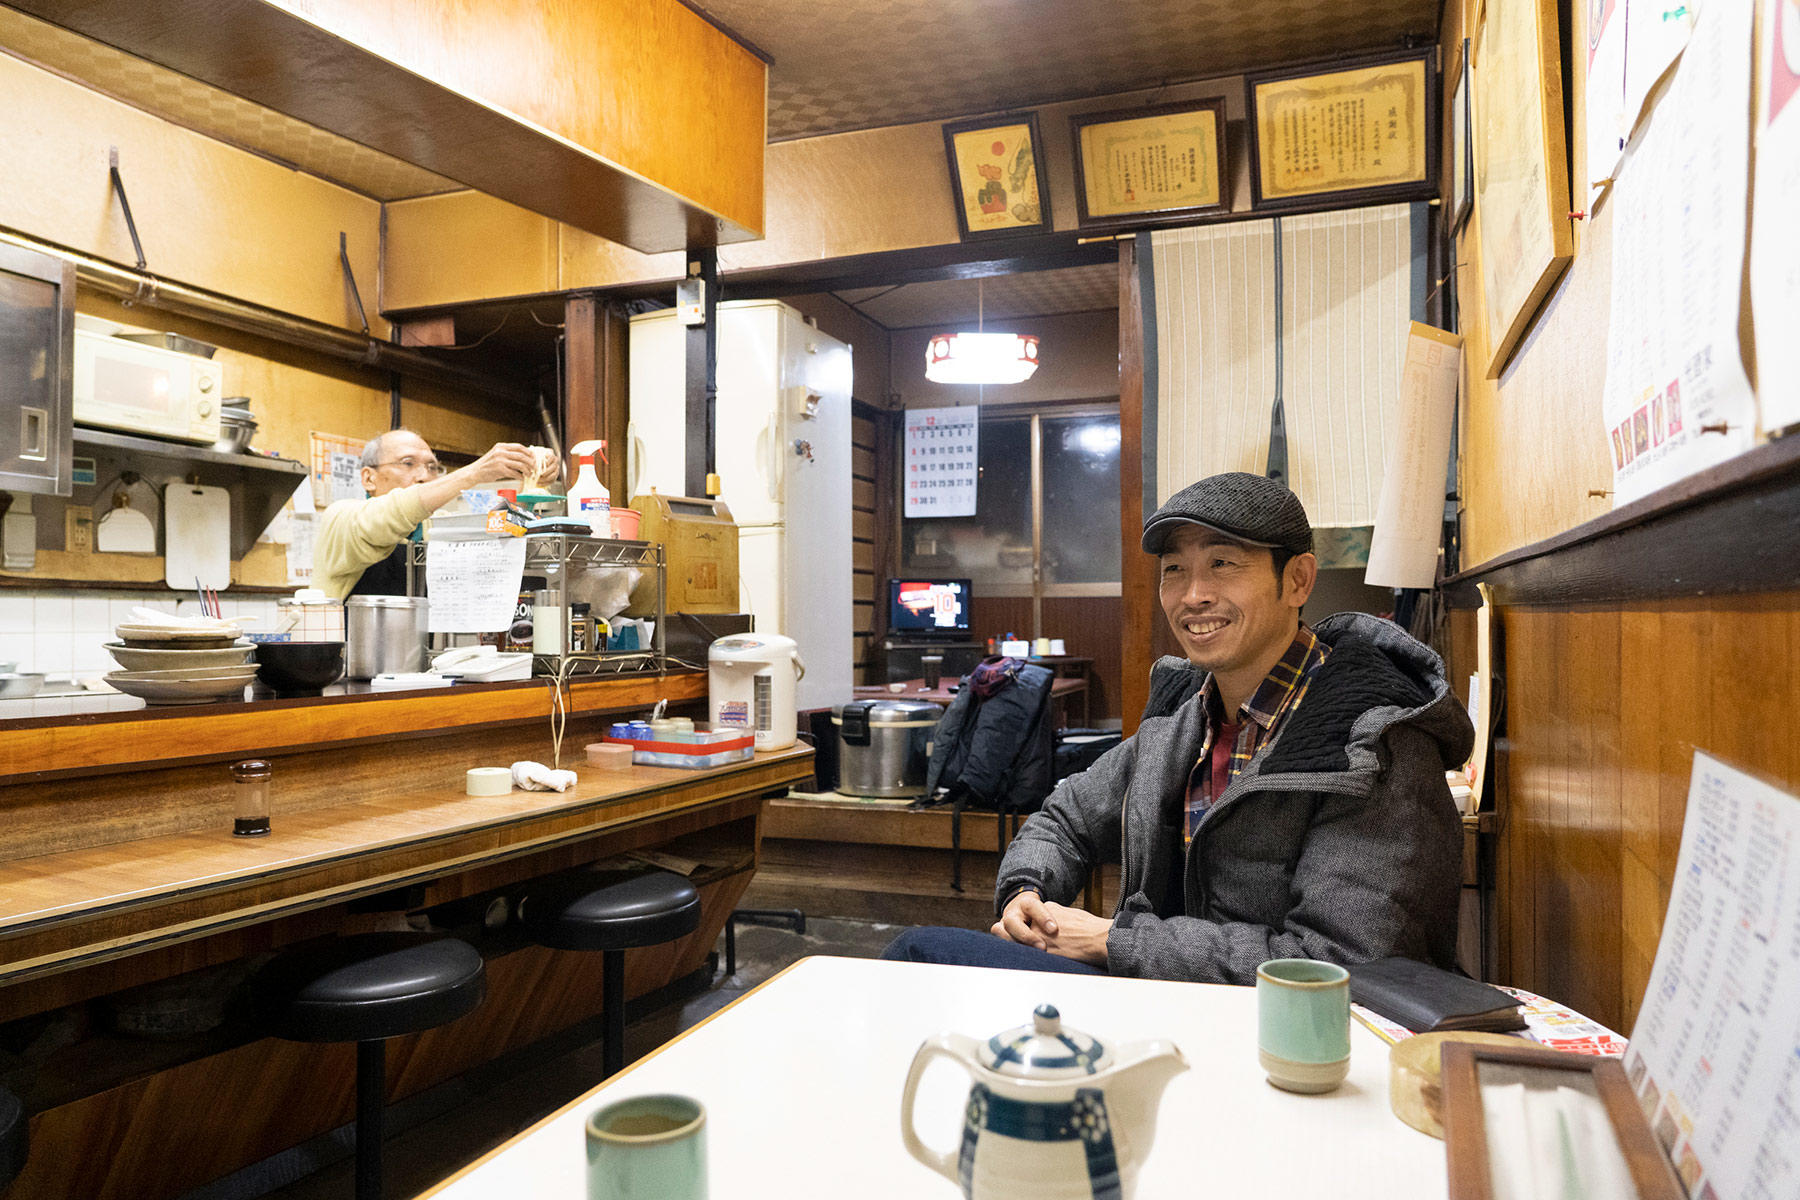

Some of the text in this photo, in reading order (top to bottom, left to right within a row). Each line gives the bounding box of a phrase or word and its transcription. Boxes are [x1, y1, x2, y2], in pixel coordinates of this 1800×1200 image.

[926, 416, 936, 426] 12
[930, 447, 936, 455] 10
[939, 446, 945, 454] 11
[948, 446, 954, 454] 12
[966, 445, 972, 453] 14
[911, 464, 917, 472] 15
[930, 463, 935, 471] 17
[956, 462, 964, 470] 20
[910, 480, 918, 488] 22
[920, 480, 927, 488] 23
[929, 480, 936, 488] 24
[957, 479, 963, 487] 27
[911, 497, 918, 505] 29
[930, 496, 937, 504] 31
[936, 594, 953, 612] 10
